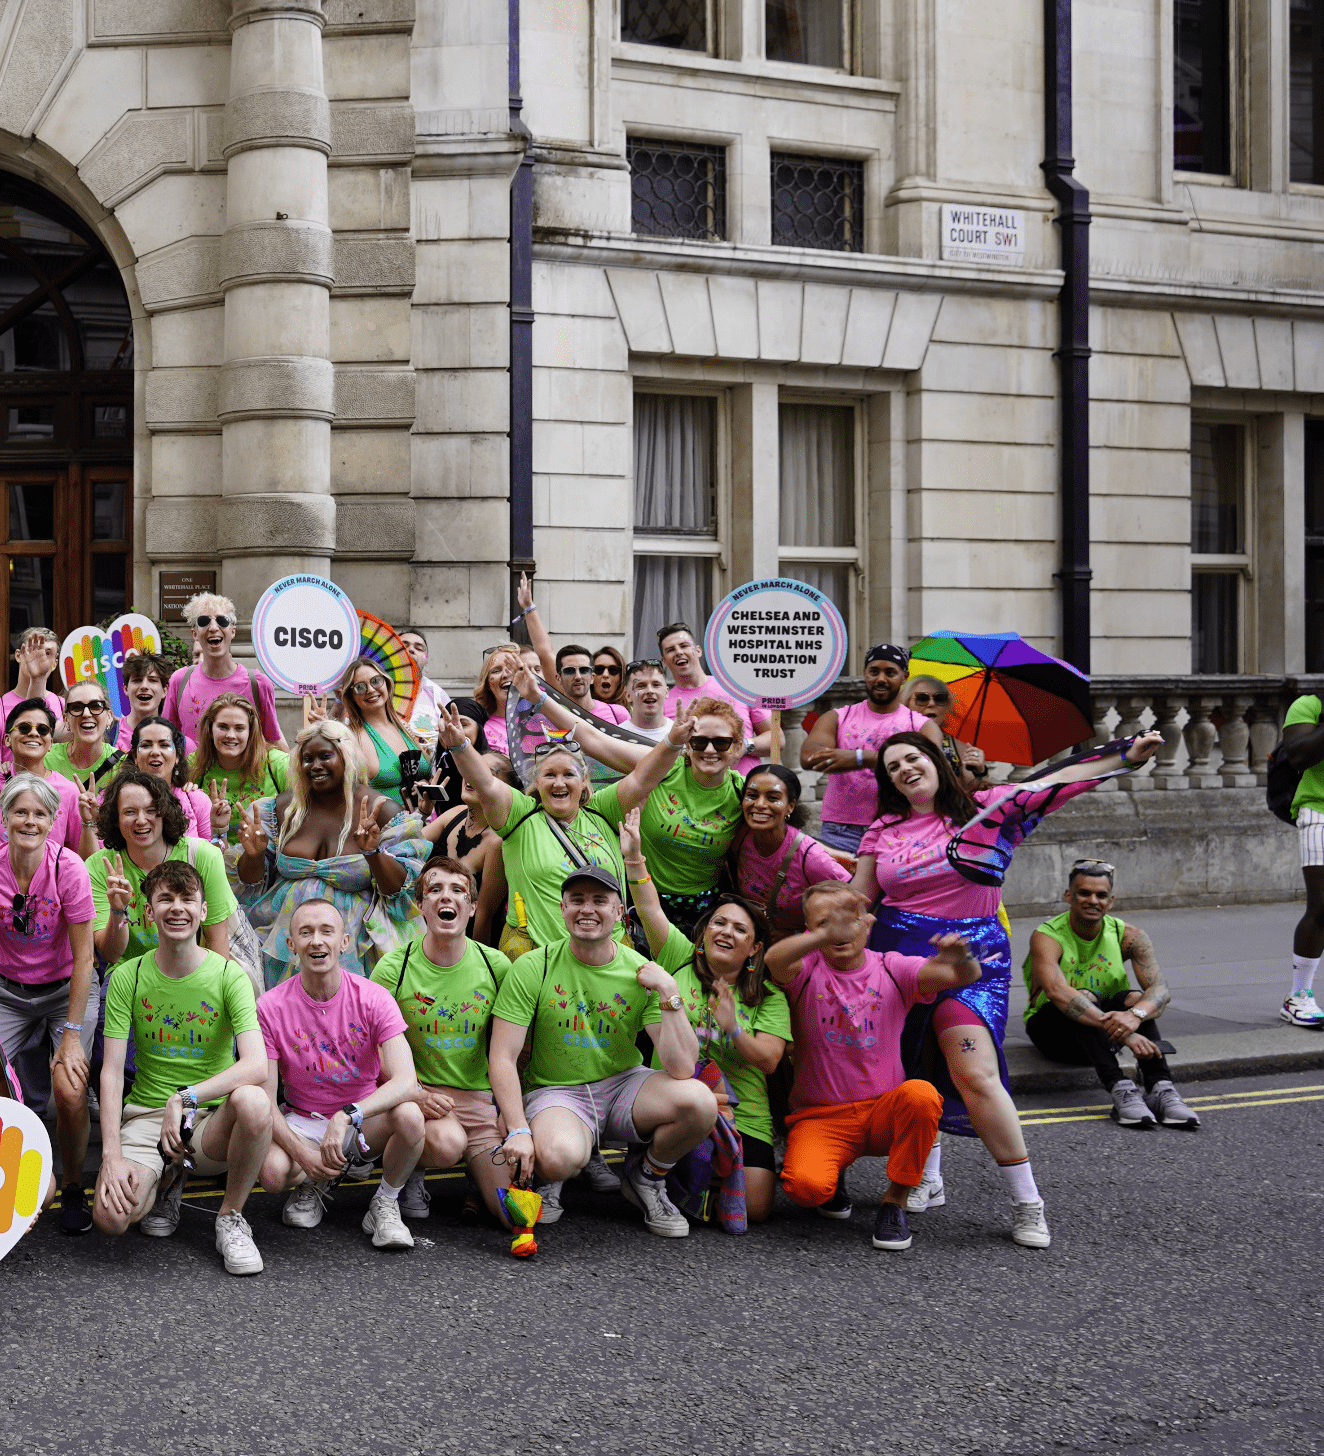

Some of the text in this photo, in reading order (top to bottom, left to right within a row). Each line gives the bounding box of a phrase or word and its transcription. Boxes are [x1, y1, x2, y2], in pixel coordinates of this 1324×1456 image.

[950, 210, 1017, 230] WHITEHALL
[950, 228, 1018, 247] COURT SW1
[274, 576, 341, 598] NEVER MARCH ALONE
[732, 581, 821, 602] NEVER MARCH ALONE
[731, 611, 821, 621] CHELSEA AND
[727, 625, 825, 636] WESTMINSTER
[274, 626, 343, 650] CISCO
[728, 639, 823, 650] HOSPITAL NHS
[733, 653, 817, 665] FOUNDATION
[753, 668, 796, 679] TRUST
[424, 1036, 476, 1050] CISCO
[825, 1030, 877, 1049] CISCO
[151, 1044, 204, 1058] CISCO
